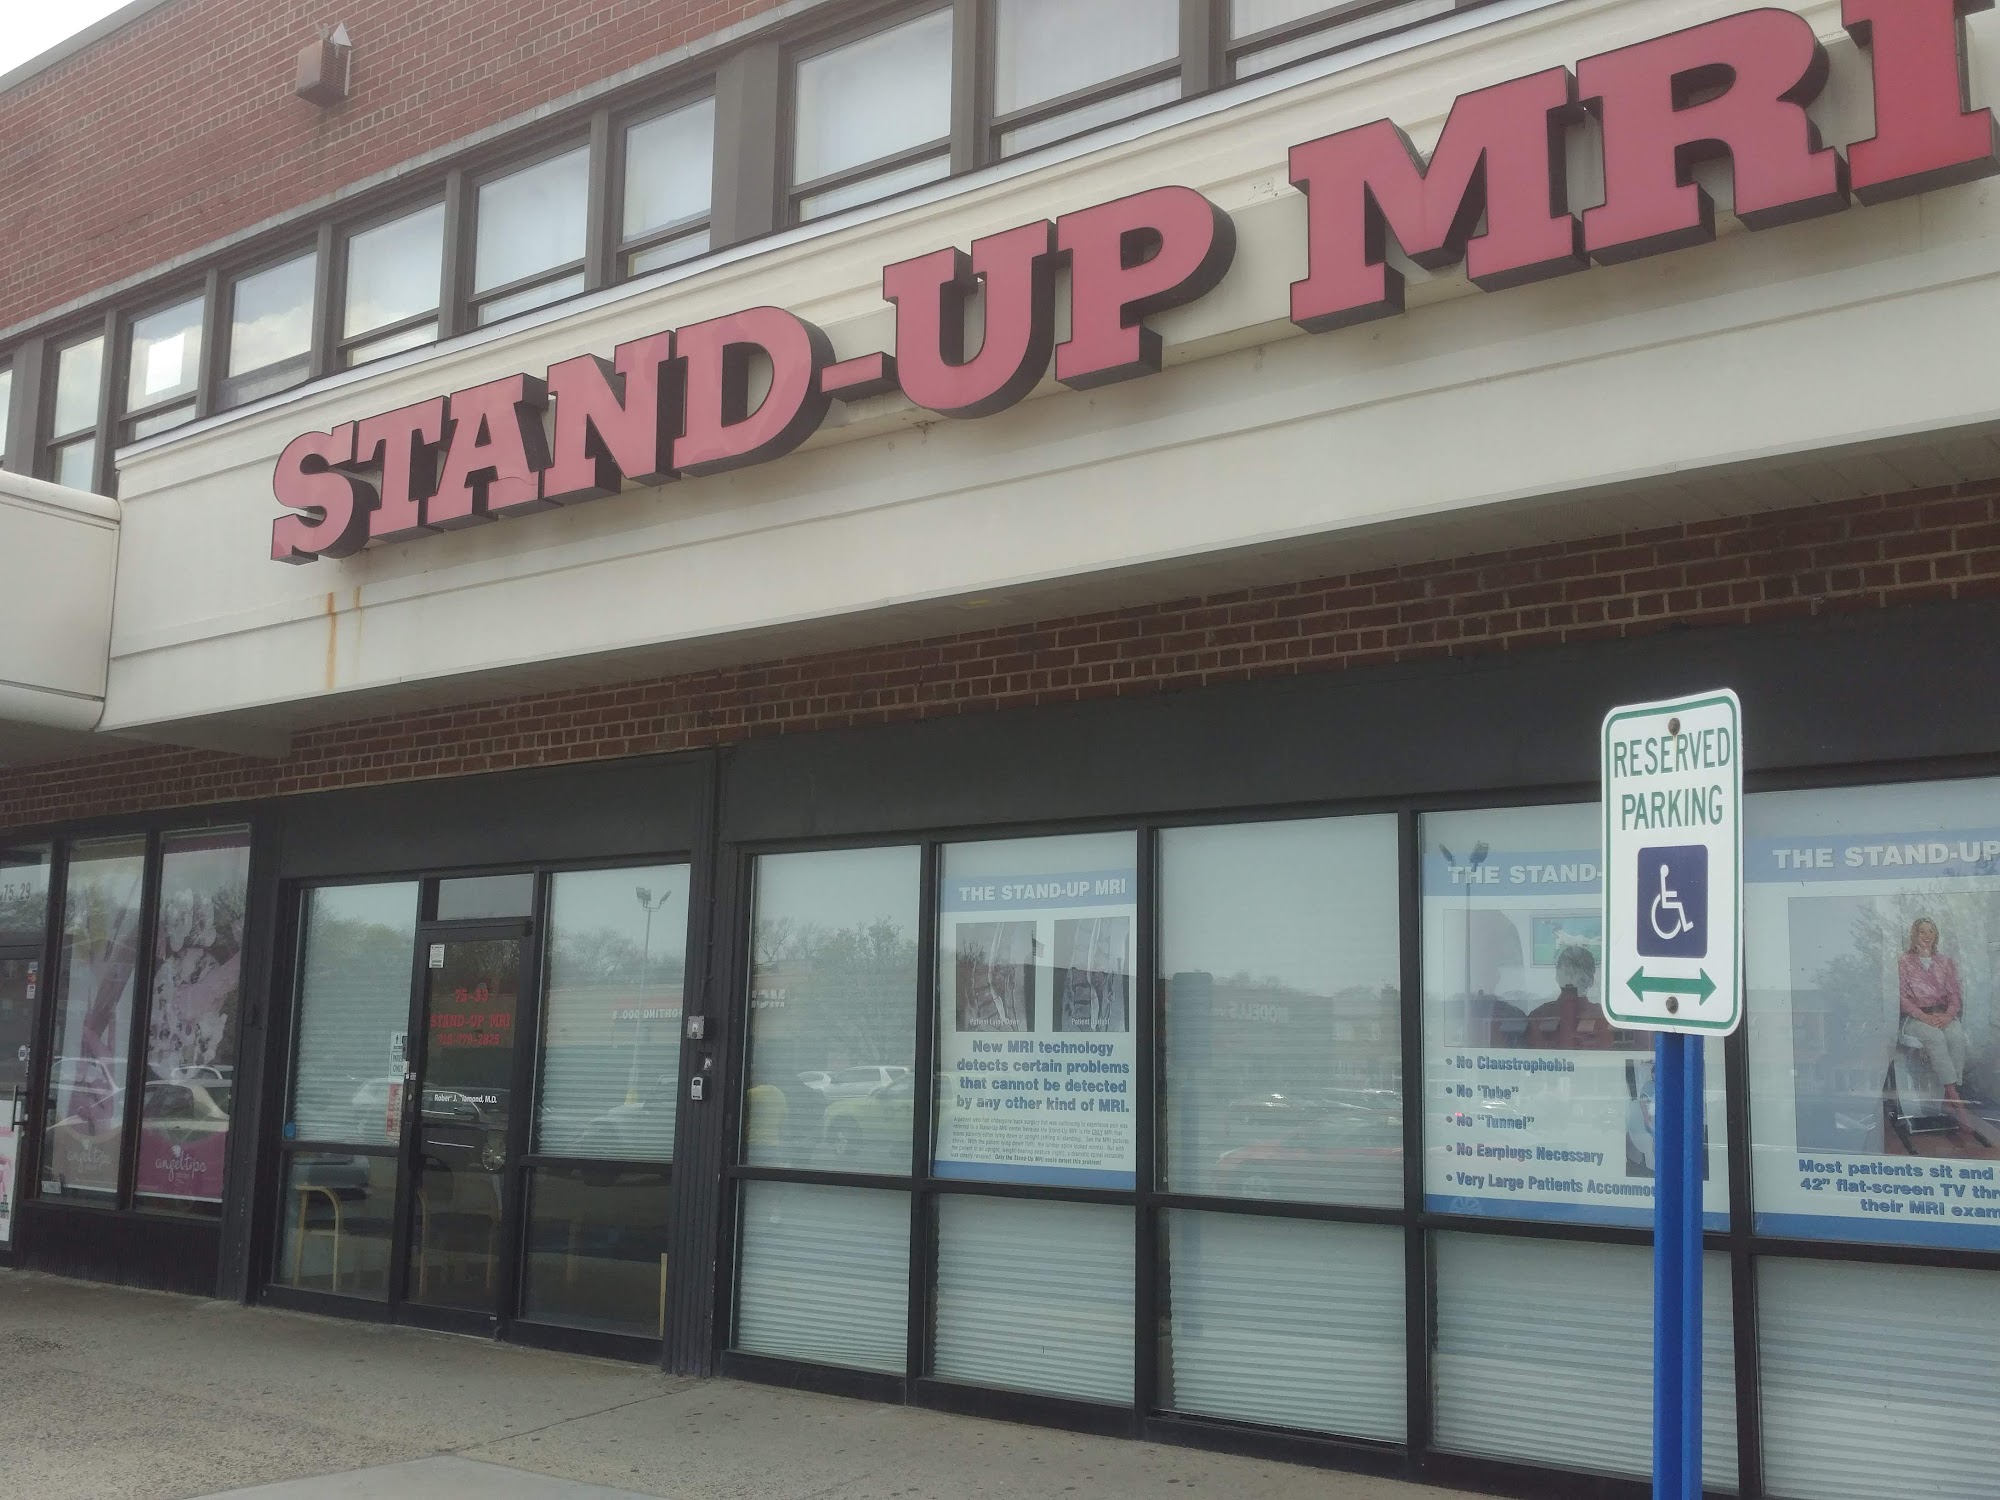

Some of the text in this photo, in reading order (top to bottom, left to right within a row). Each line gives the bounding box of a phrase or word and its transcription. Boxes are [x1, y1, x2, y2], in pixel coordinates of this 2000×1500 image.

[270, 0, 1998, 563] STAND-UP MRI
[1614, 727, 1730, 779] RESERVED
[1622, 784, 1723, 830] PARKING
[1773, 840, 2000, 869] THE STAND-UP
[1448, 866, 1500, 884] THE
[959, 878, 1126, 901] THE STAND-UP MRI
[973, 1040, 1114, 1056] New MRI technology
[957, 1058, 1130, 1075] detects certain problems
[1457, 1056, 1575, 1074] No Claustrophobia
[960, 1076, 1127, 1093] that cannot be detected
[1457, 1085, 1473, 1098] No
[957, 1095, 1130, 1112] by any other kind of MRI.
[1457, 1114, 1473, 1127] No
[1457, 1142, 1604, 1166] No Earplugs Necessary
[1799, 1159, 1842, 1174] Most
[1849, 1161, 1923, 1177] patients
[1930, 1164, 1952, 1178] sit
[1959, 1166, 1993, 1180] and
[1457, 1172, 1485, 1189] Very
[1489, 1174, 1524, 1191] Large
[1529, 1176, 1583, 1193] Patients
[1836, 1178, 1934, 1196] flat-screen
[1940, 1183, 1966, 1198] TV
[1861, 1199, 2000, 1219] their MRI exam
